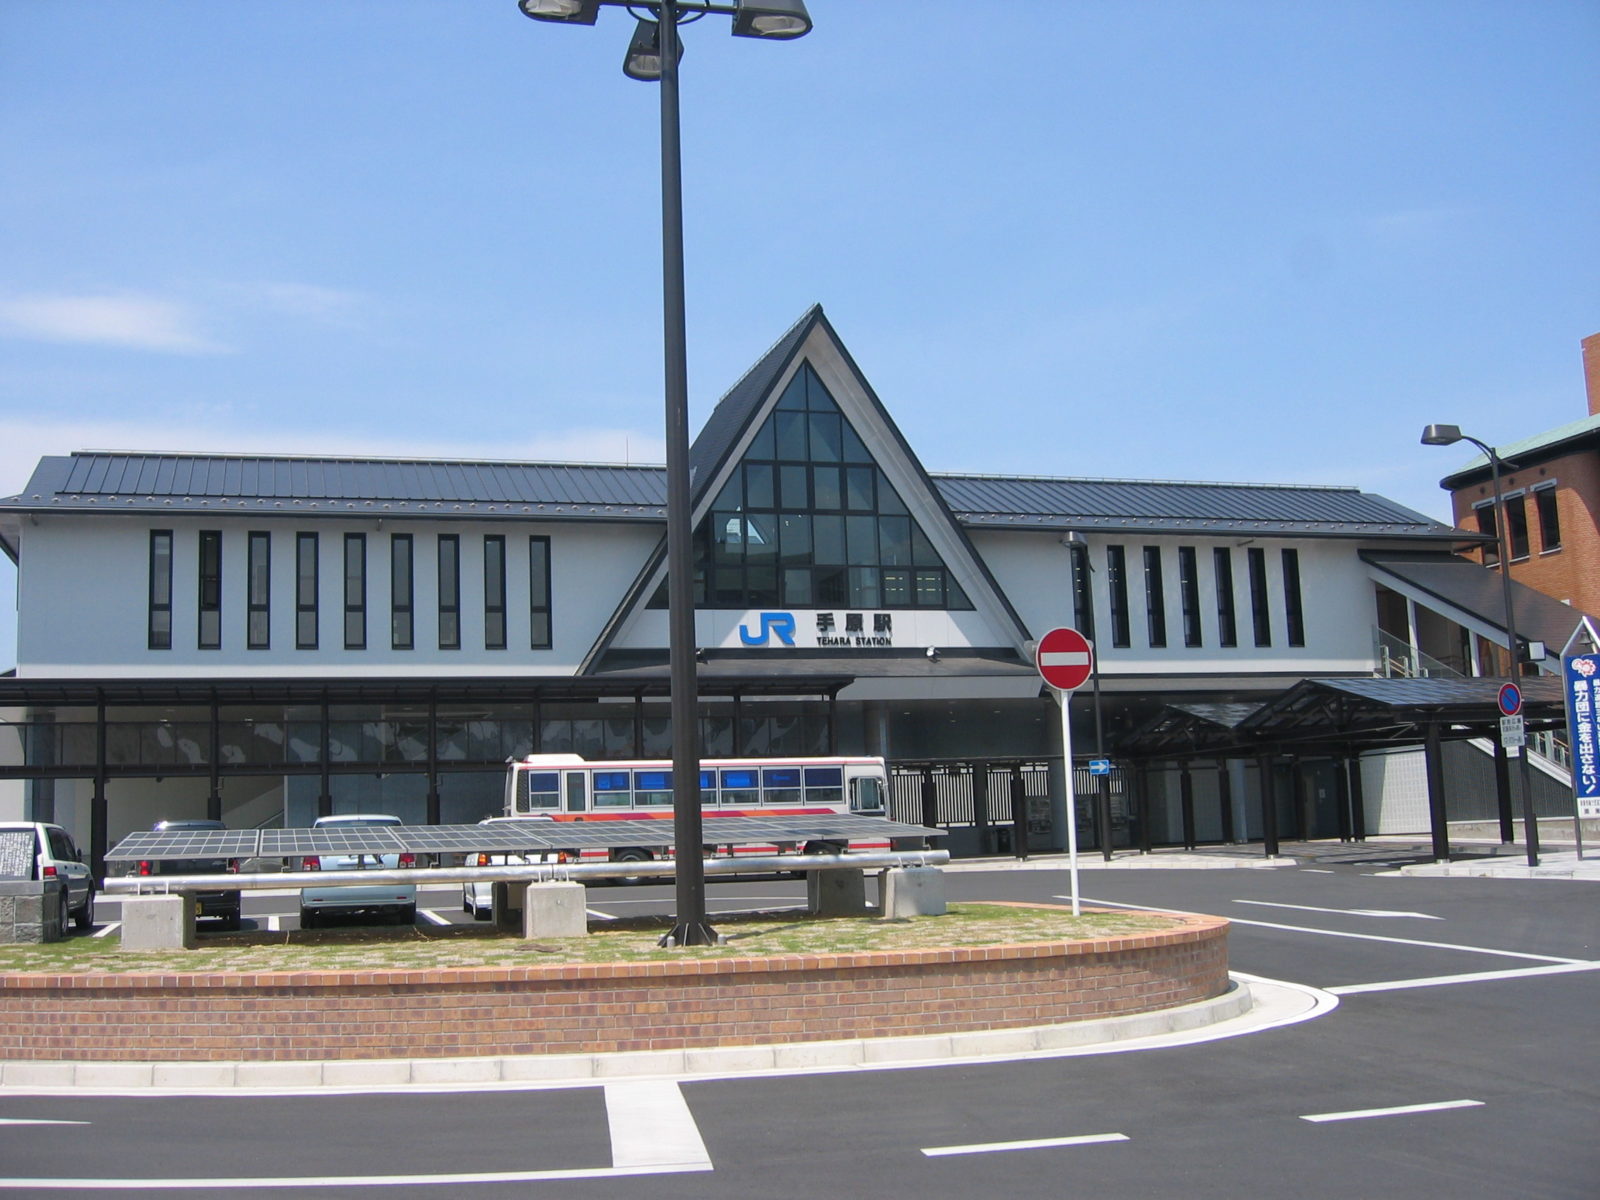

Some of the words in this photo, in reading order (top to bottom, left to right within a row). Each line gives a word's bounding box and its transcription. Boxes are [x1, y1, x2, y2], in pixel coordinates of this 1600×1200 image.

[739, 612, 796, 645] JR
[816, 612, 892, 632] 手原駅
[816, 636, 851, 646] TEHARA
[855, 636, 892, 646] STATION
